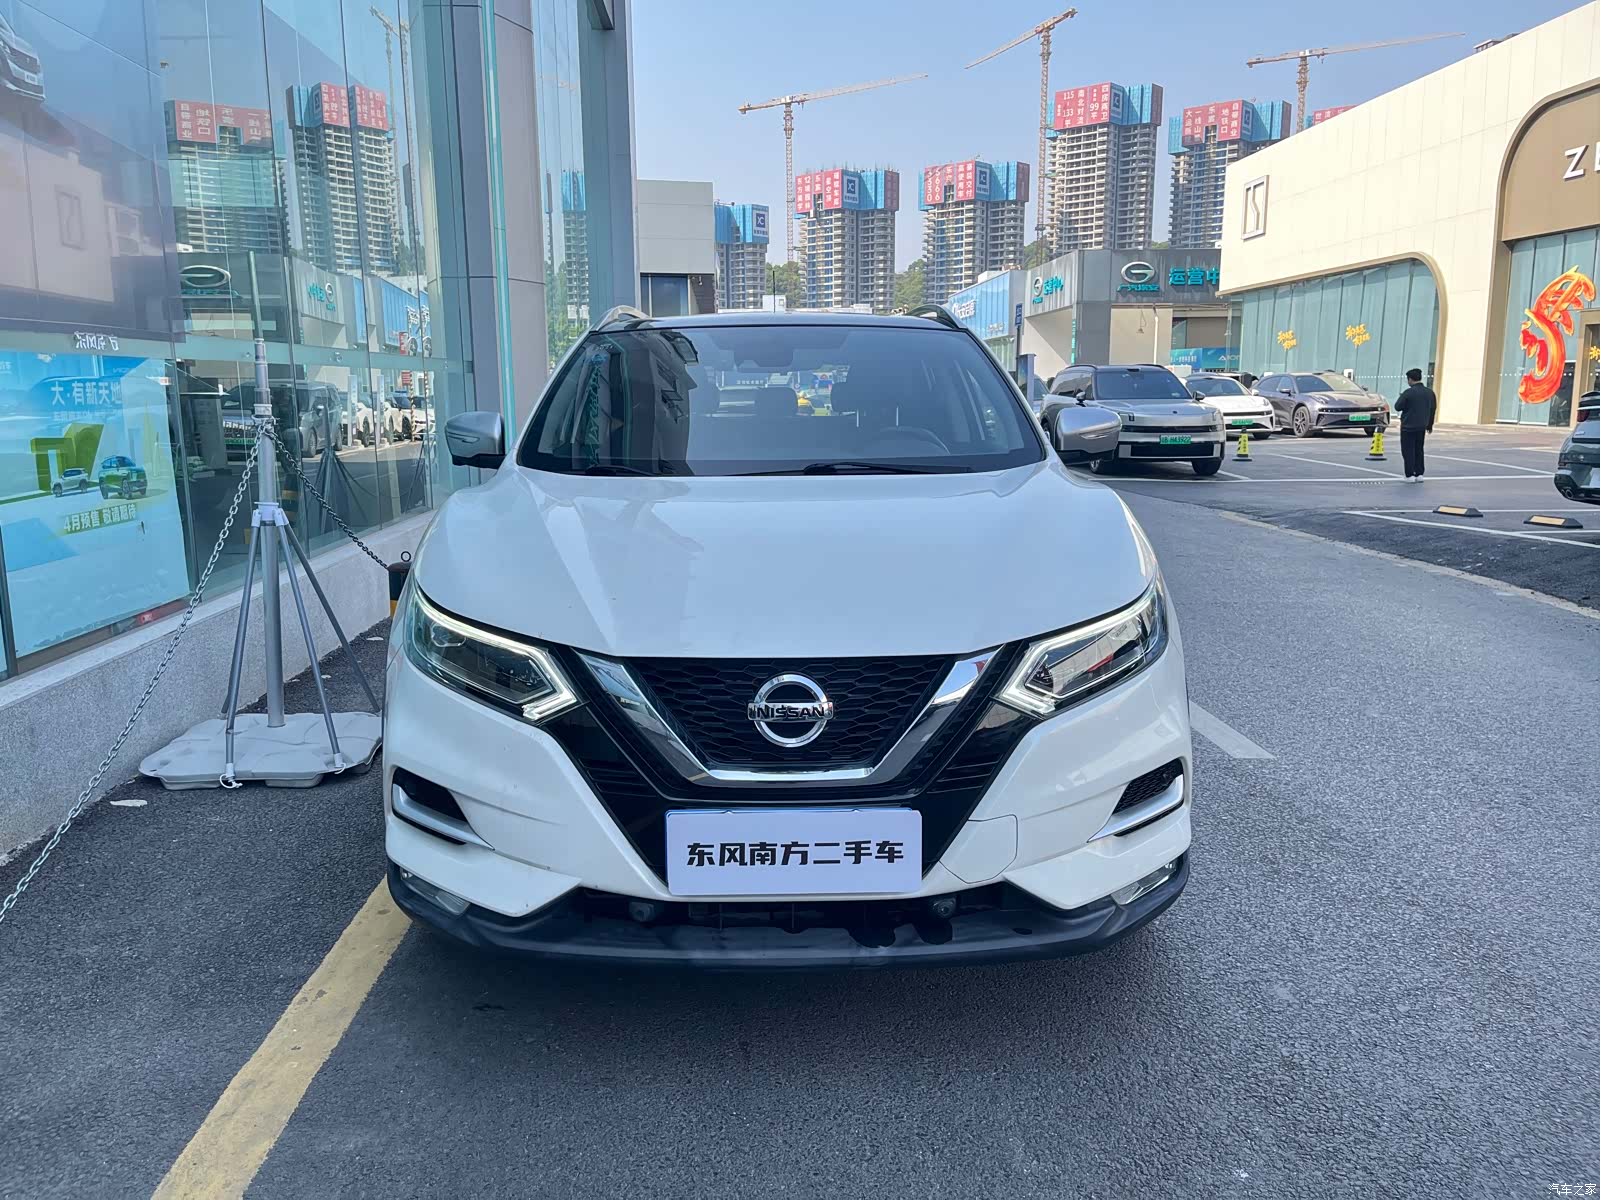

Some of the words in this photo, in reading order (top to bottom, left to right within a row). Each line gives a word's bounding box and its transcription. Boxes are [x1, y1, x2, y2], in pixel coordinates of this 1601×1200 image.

[756, 705, 825, 719] NISSAN
[686, 840, 904, 867] 东风南方二手车
